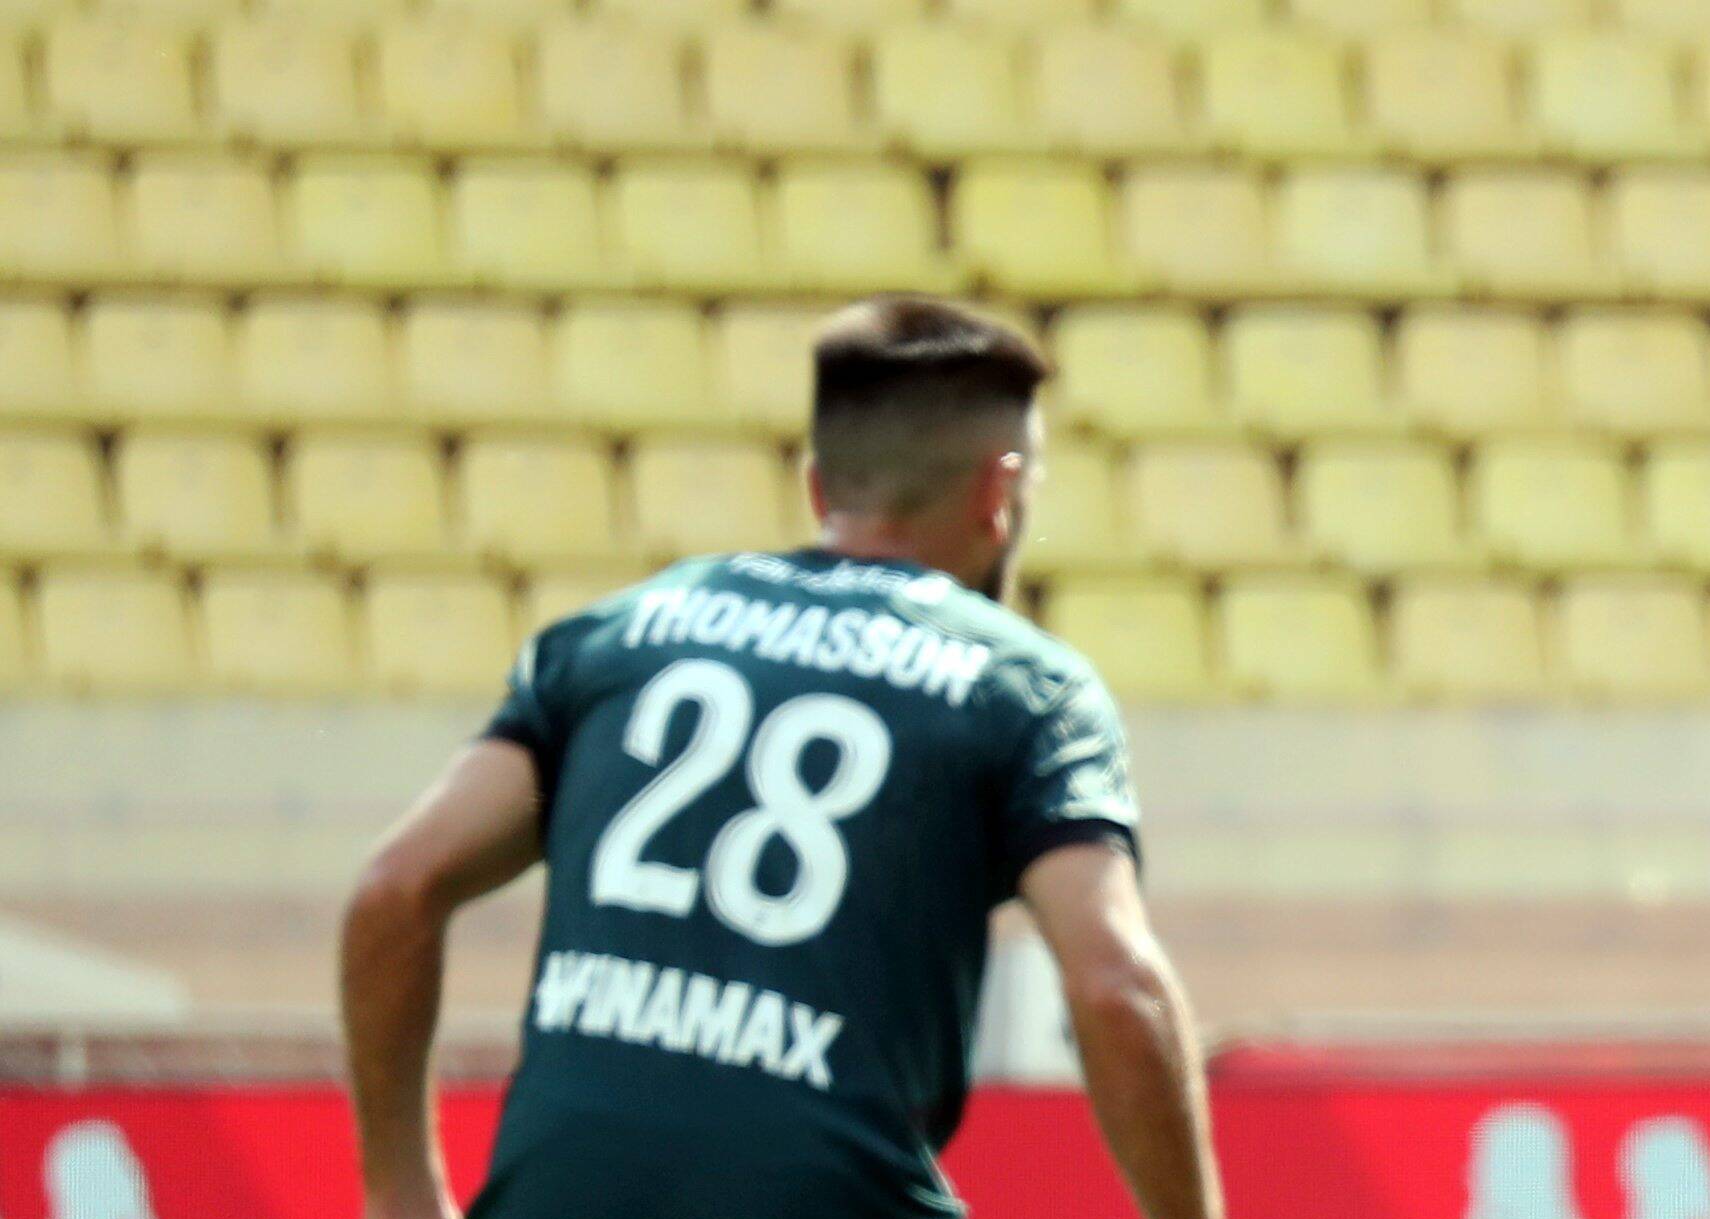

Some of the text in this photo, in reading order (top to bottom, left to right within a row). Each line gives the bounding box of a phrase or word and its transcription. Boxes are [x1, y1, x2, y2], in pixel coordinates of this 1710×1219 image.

[623, 588, 990, 706] THOMASSON
[590, 658, 893, 948] 28
[533, 949, 845, 1093] WINAMAX
